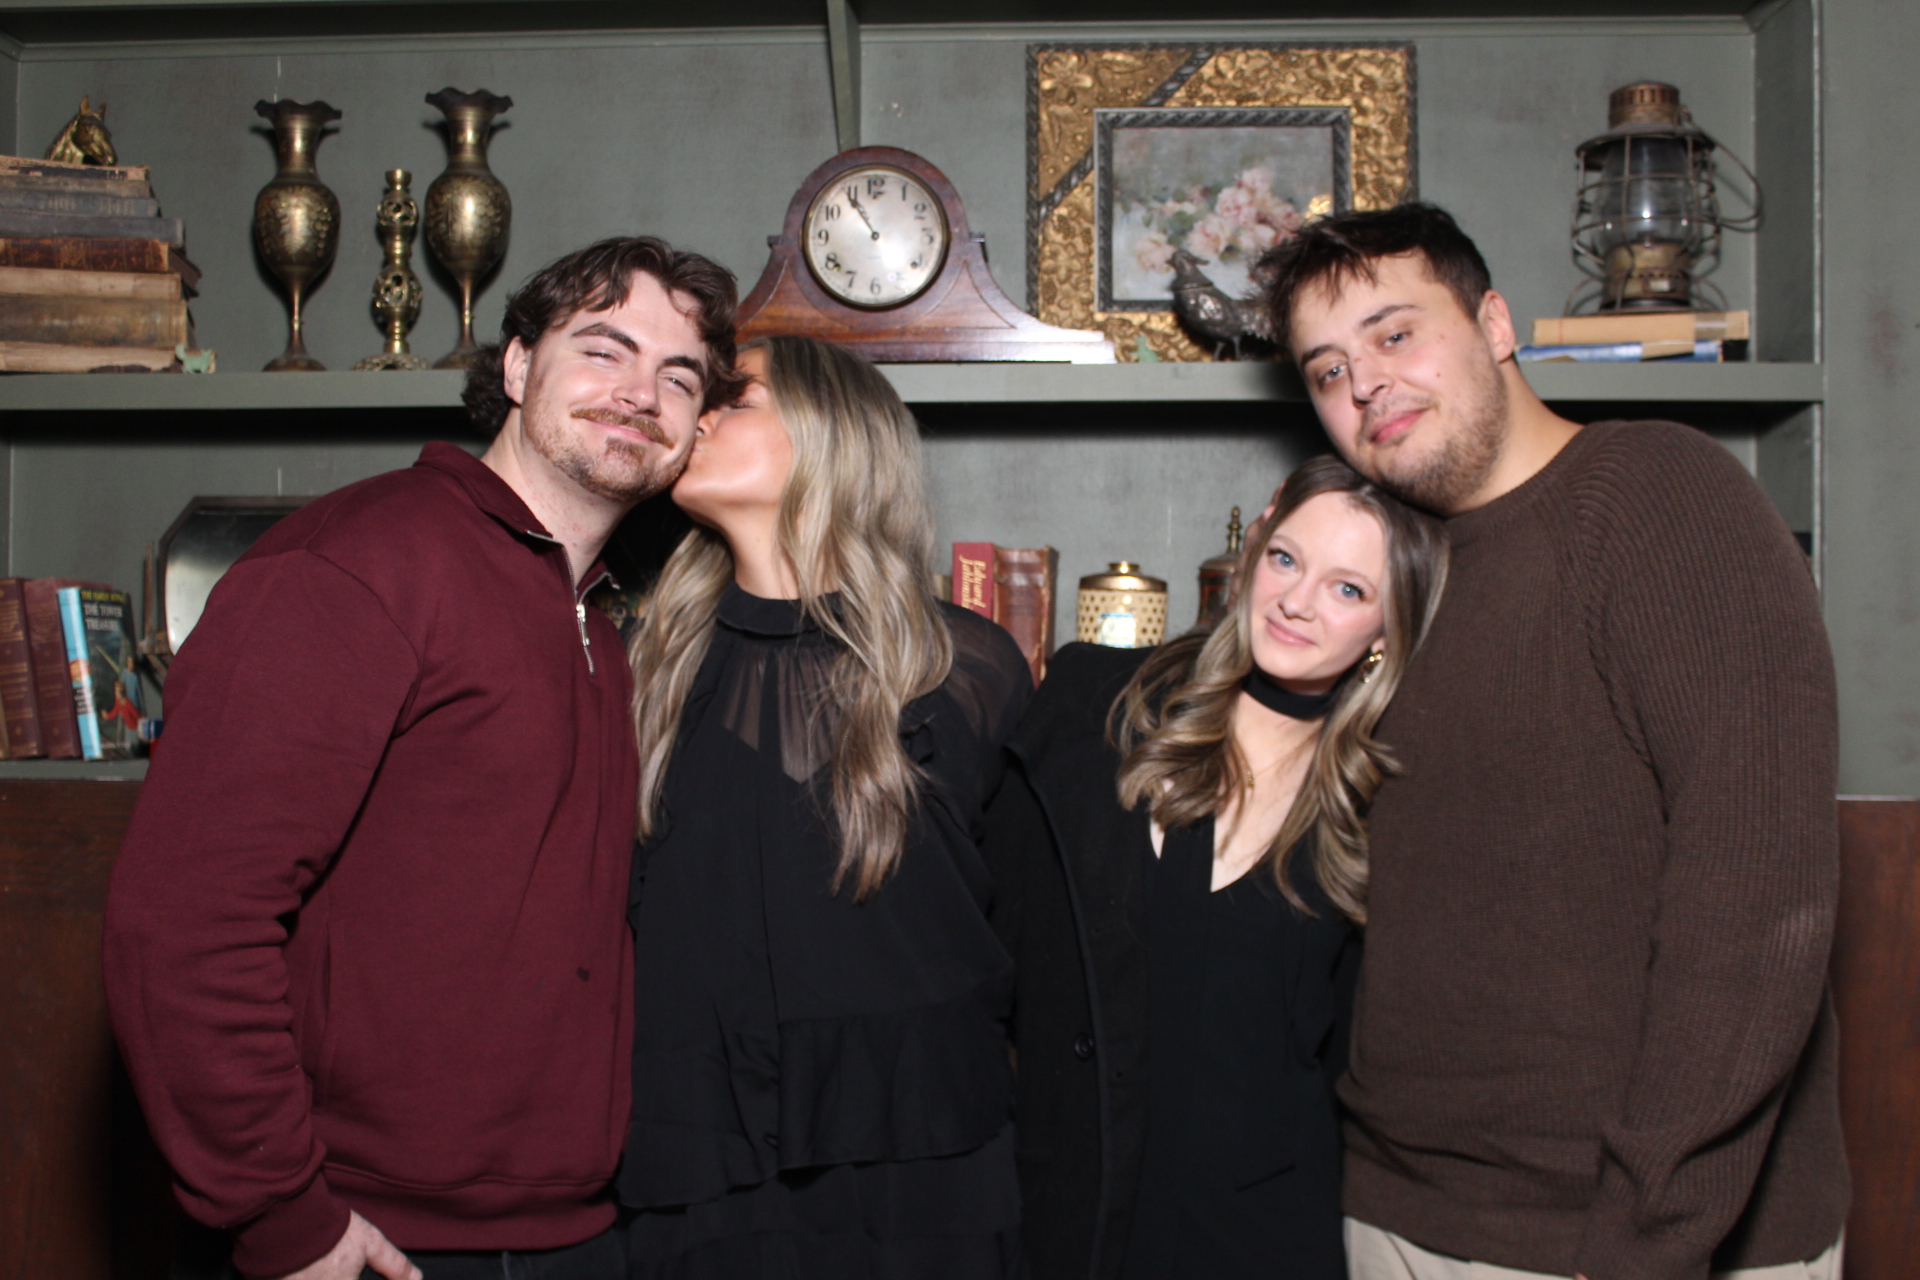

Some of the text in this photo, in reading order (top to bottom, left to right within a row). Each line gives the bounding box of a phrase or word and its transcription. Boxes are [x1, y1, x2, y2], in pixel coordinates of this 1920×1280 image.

[867, 178, 885, 199] 12
[901, 182, 908, 201] 1
[825, 204, 841, 221] 10
[914, 202, 927, 220] 2
[818, 229, 829, 246] 9
[825, 252, 838, 270] 8
[845, 270, 857, 288] 7
[870, 277, 881, 295] 6
[973, 559, 987, 608] Edward
[83, 603, 122, 617] THE TOWER
[84, 618, 119, 631] TREASURE
